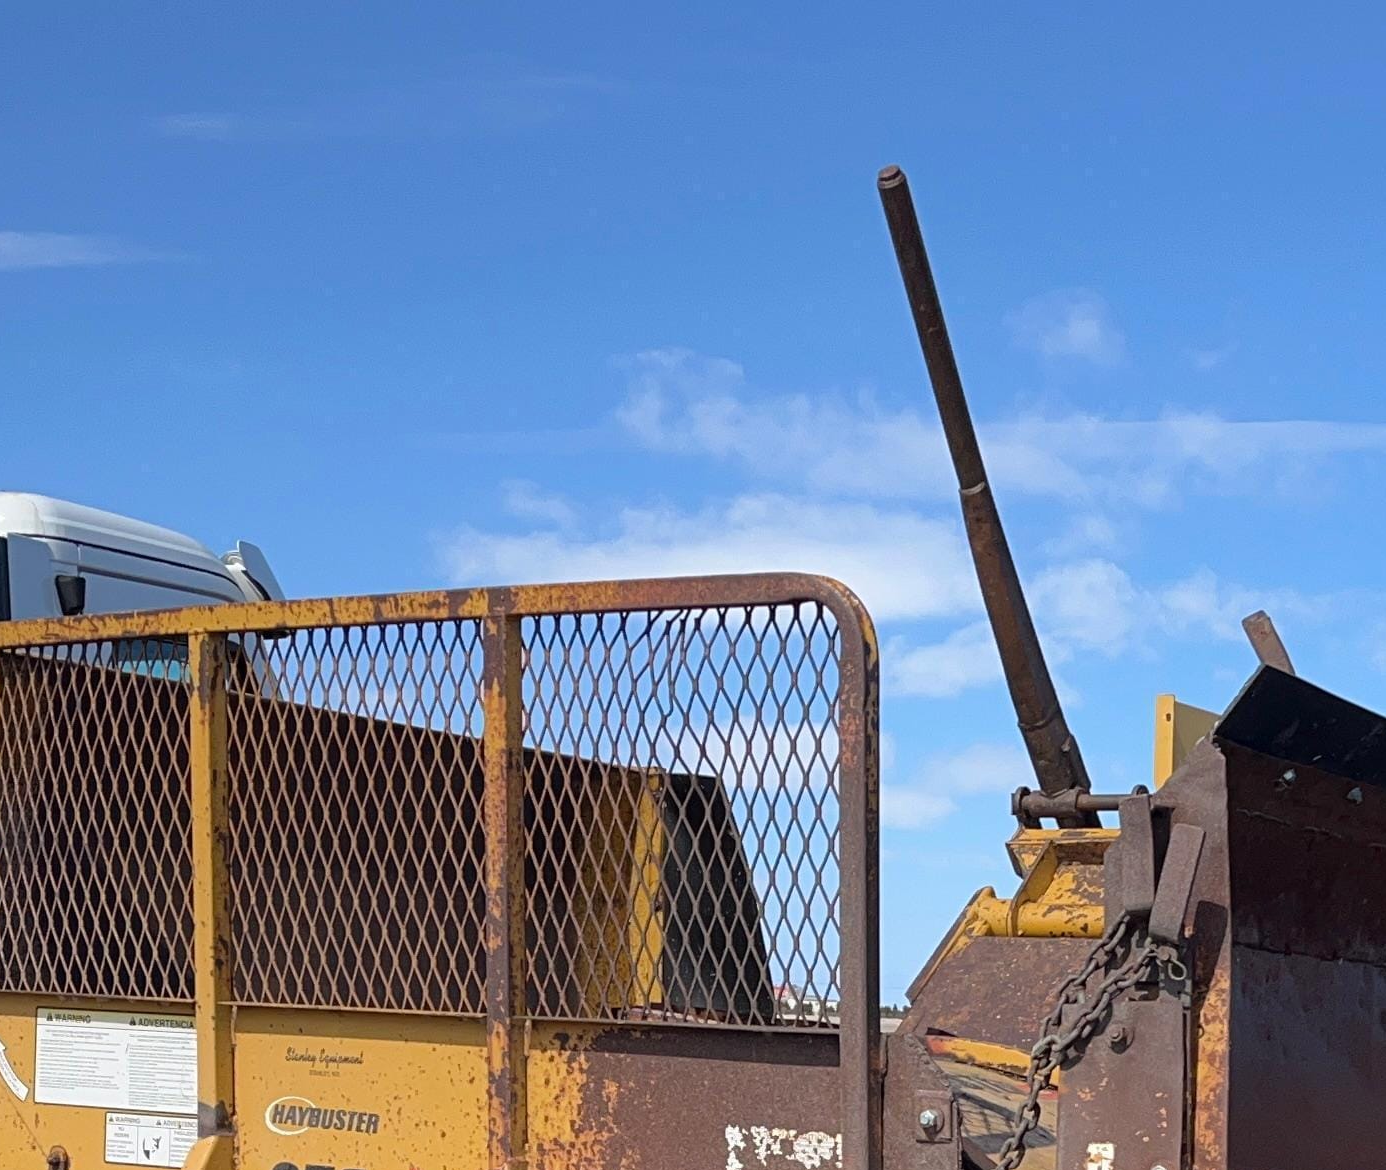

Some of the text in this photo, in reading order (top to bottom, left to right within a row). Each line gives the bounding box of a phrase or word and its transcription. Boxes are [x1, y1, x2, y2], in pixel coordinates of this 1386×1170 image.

[54, 1013, 92, 1024] WARNING
[138, 1017, 194, 1029] ADVERTENCIA
[319, 1047, 365, 1069] Equipment
[272, 1103, 381, 1135] HAYBUSTER
